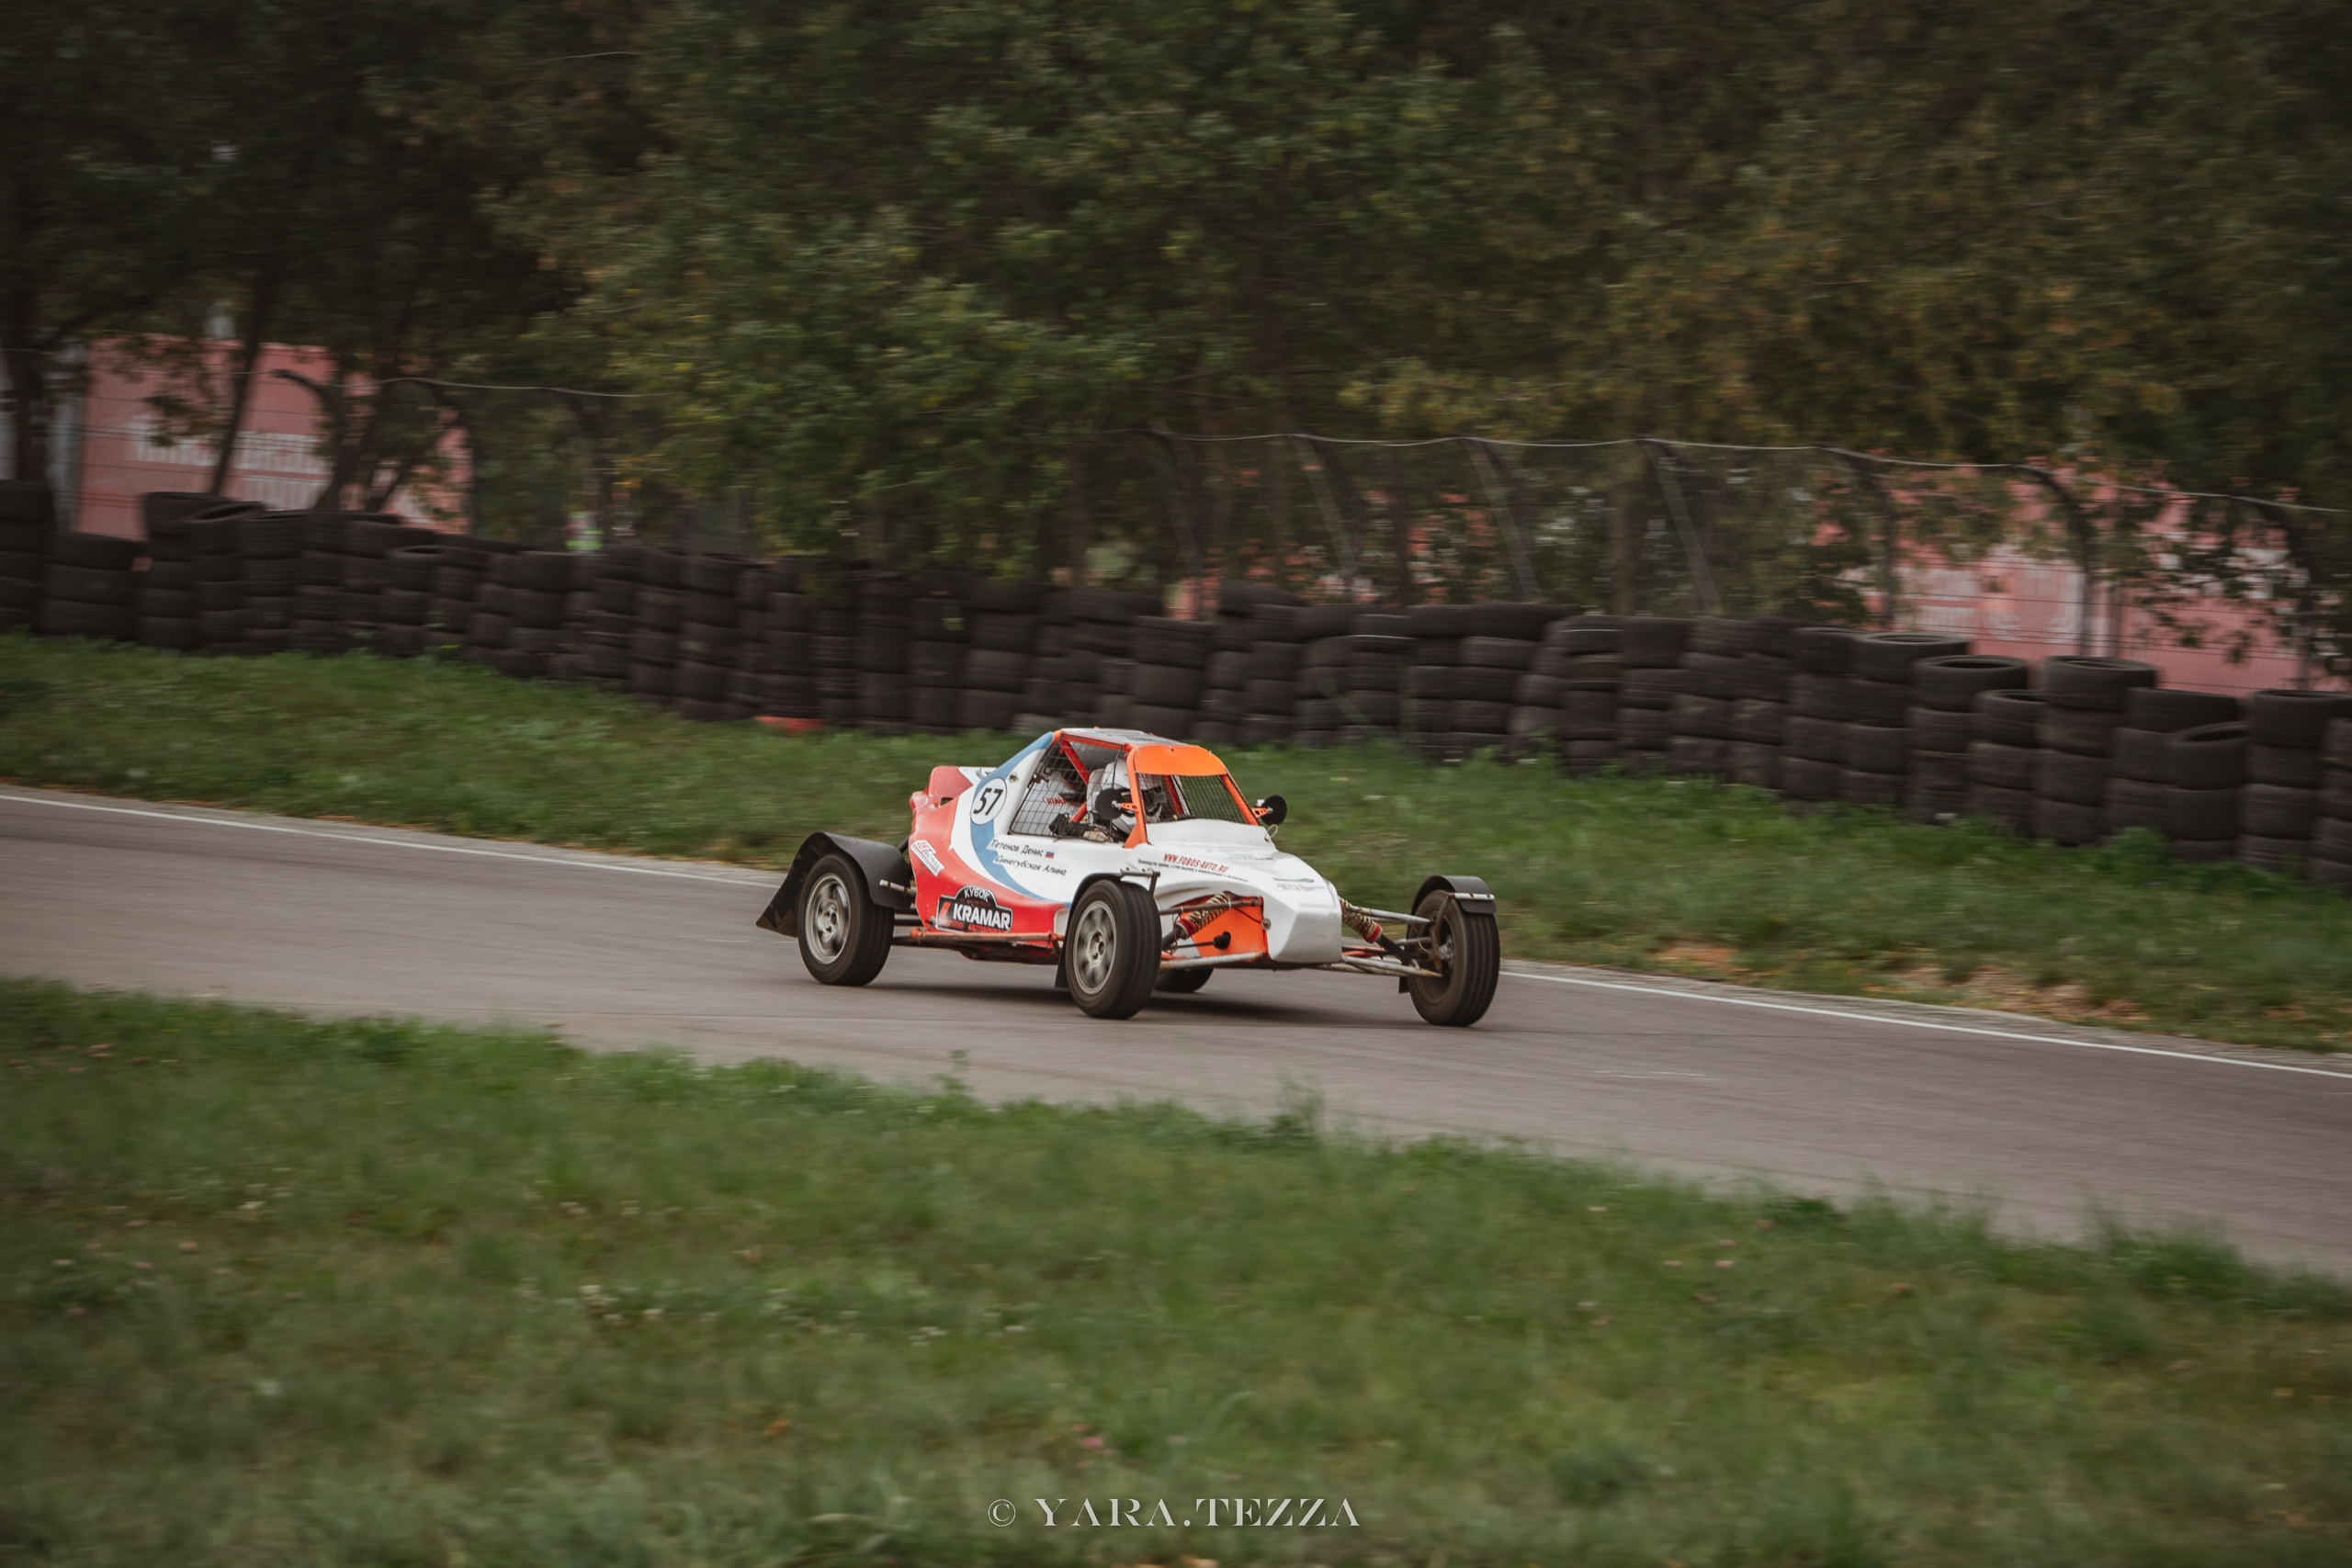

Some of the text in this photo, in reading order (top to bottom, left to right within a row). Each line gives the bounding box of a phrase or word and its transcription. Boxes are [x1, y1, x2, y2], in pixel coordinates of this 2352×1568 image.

[973, 787, 1004, 816] 57
[990, 839, 1045, 856] Тетенов Денис
[1043, 864, 1068, 876] Алина
[964, 886, 991, 903] КУБОК
[952, 902, 1012, 931] KRAMAR
